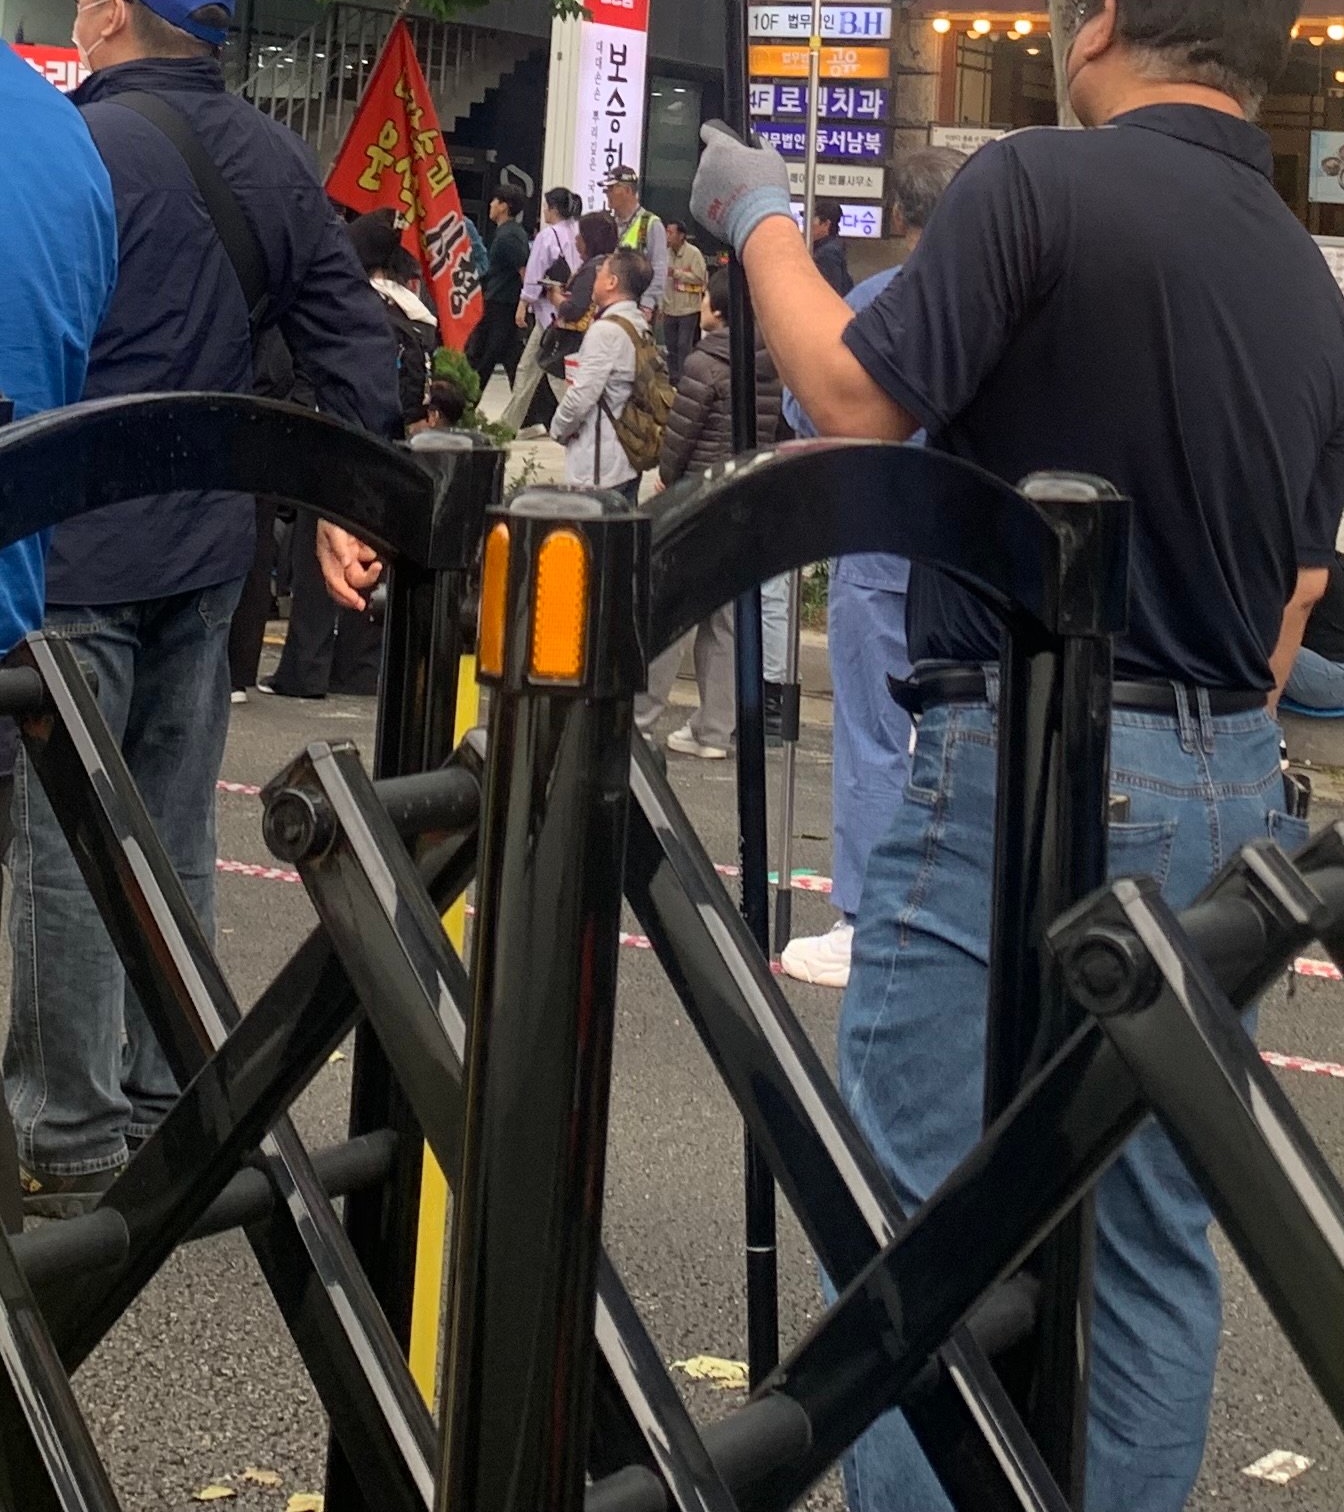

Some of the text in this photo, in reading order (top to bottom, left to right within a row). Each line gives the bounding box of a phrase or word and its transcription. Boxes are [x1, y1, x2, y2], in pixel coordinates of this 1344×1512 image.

[753, 13, 779, 30] 10F
[788, 13, 835, 30] 법무인
[782, 51, 811, 65] 법무법
[750, 90, 770, 109] 4F
[603, 42, 628, 207] 보승회
[816, 130, 881, 155] 동서남북
[829, 174, 873, 186] 법률사무소
